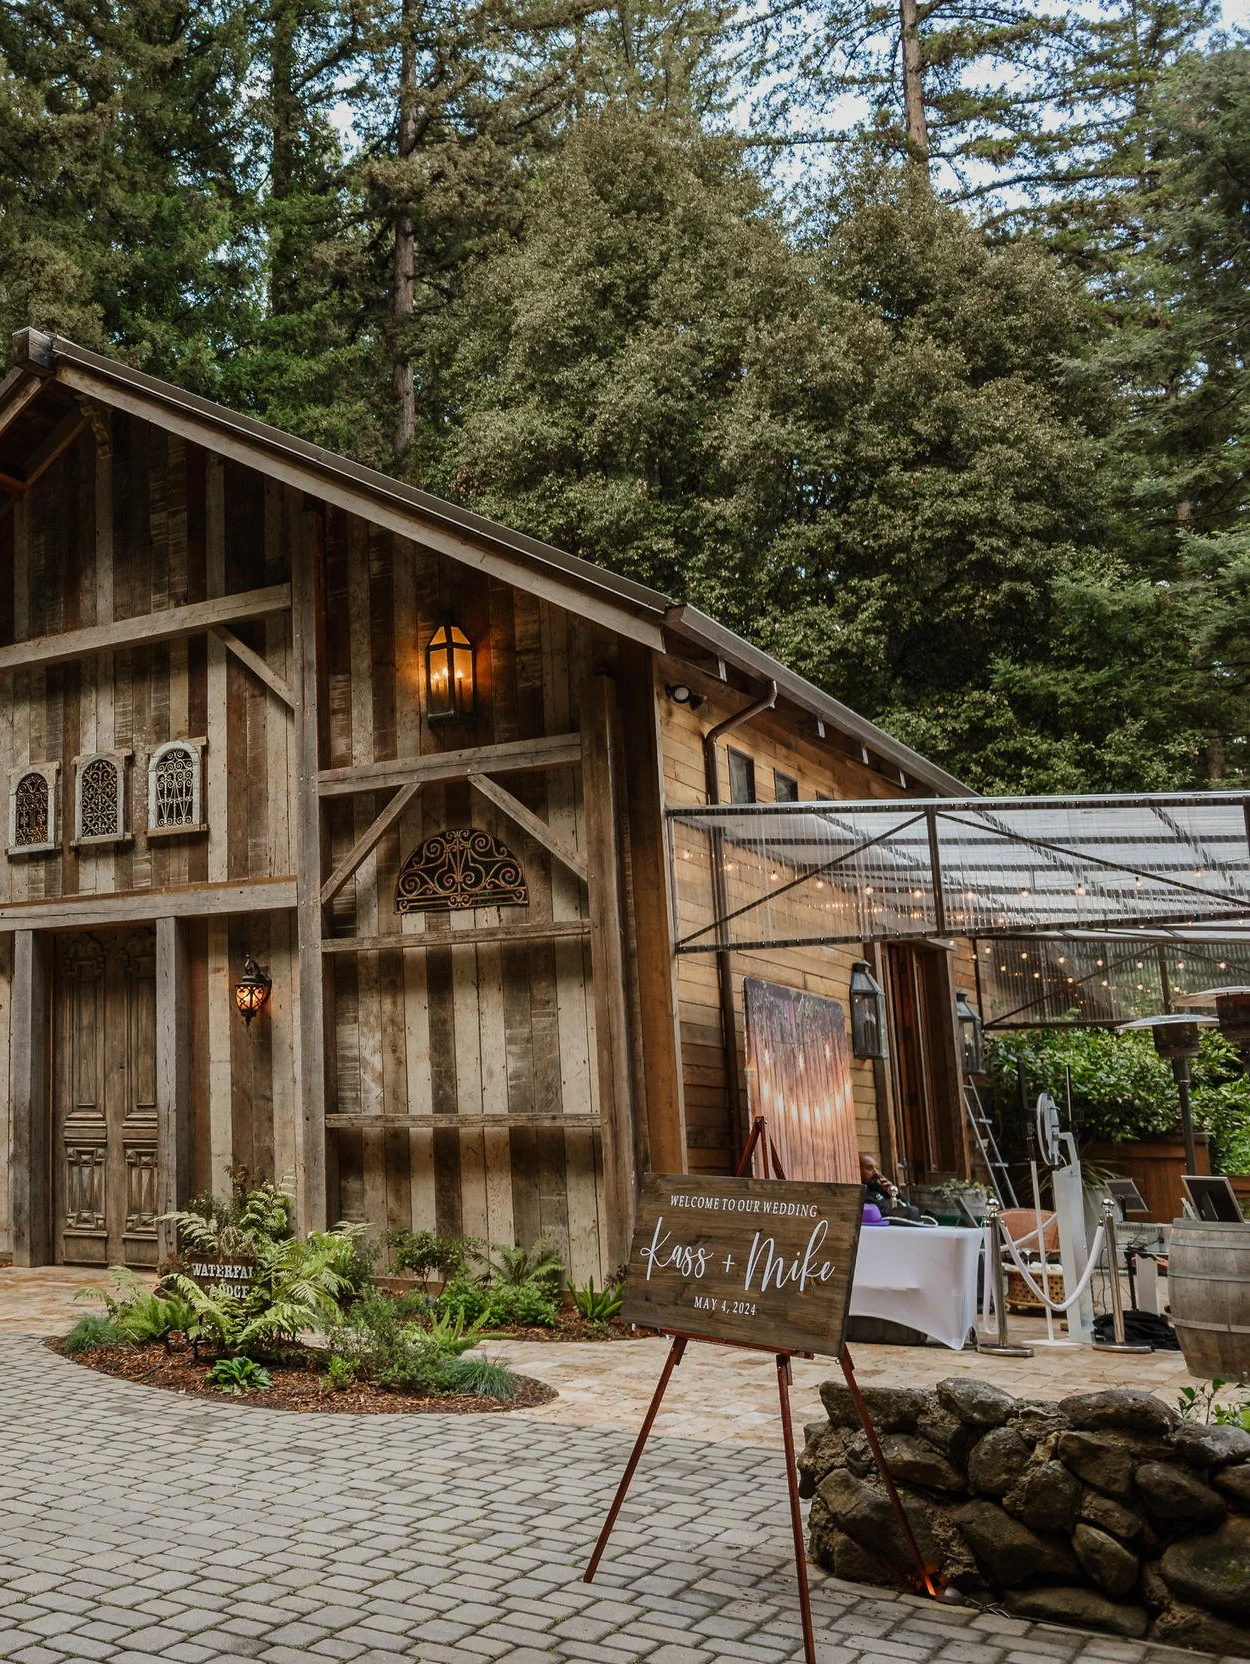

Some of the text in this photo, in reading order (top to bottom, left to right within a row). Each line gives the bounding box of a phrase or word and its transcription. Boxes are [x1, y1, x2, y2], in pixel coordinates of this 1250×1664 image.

[670, 1195, 818, 1218] WELCOME TO OUR WEDDING
[640, 1216, 836, 1292] Kass + Mike
[693, 1295, 756, 1316] MAY 4, 2024
